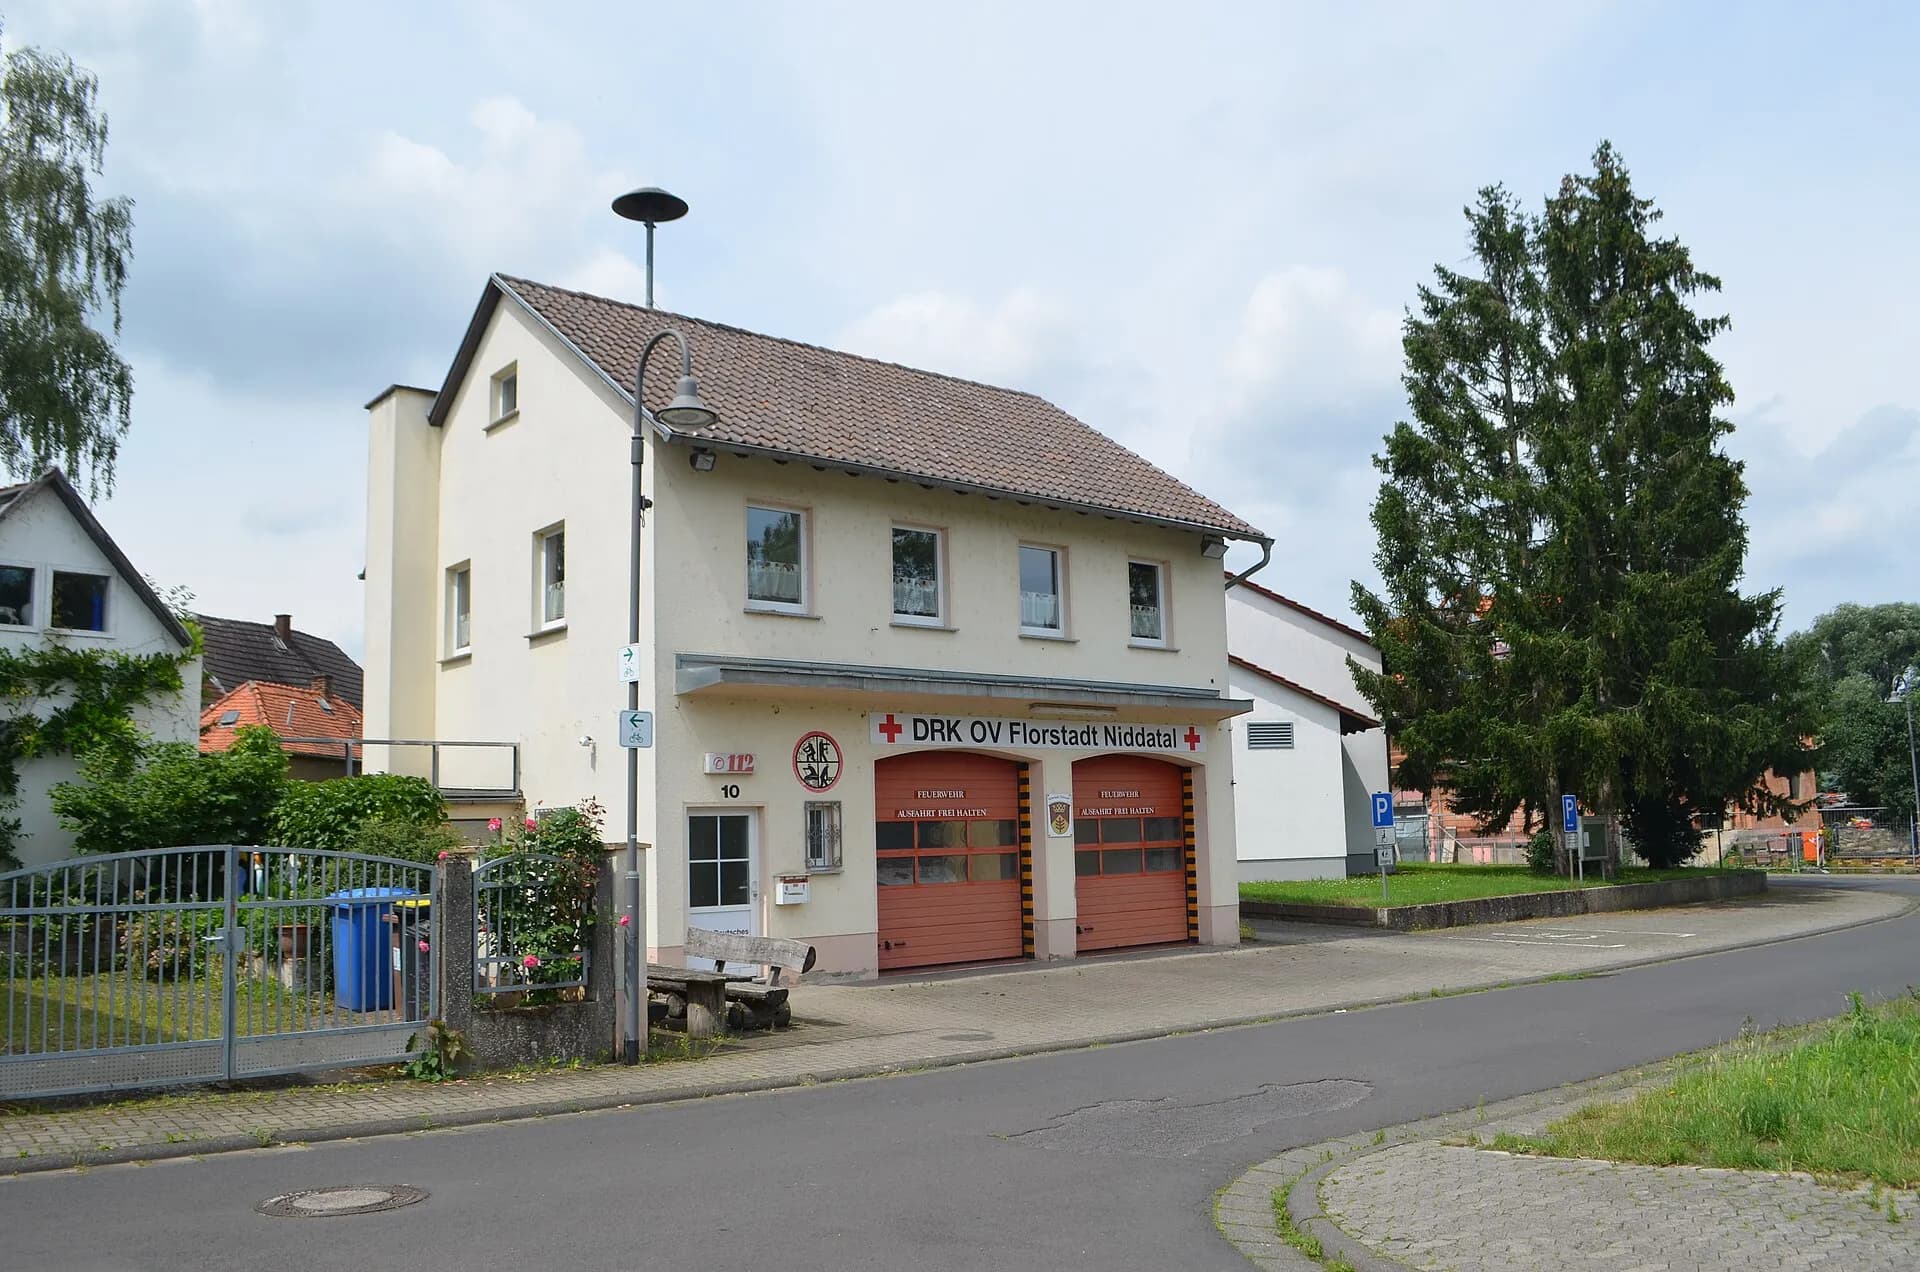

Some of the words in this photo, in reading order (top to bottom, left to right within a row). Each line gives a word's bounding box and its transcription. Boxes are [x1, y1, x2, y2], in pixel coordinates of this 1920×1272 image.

[912, 717, 963, 743] DRK
[970, 720, 1002, 744] OV
[1009, 722, 1099, 746] Florstadt
[1104, 725, 1177, 748] Niddatal
[727, 753, 755, 772] 112
[721, 784, 740, 799] 10
[917, 790, 965, 799] FEUERWEHR
[1101, 790, 1139, 798] FEUERWEHR
[897, 809, 936, 818] AUSFAHRT
[938, 809, 955, 817] FREI
[956, 808, 987, 817] HALTEN
[1081, 807, 1112, 816] AUSFAHRT
[1114, 807, 1128, 815] FREI
[1129, 806, 1154, 815] HALTEN
[1376, 797, 1388, 823] P
[1565, 799, 1574, 820] P
